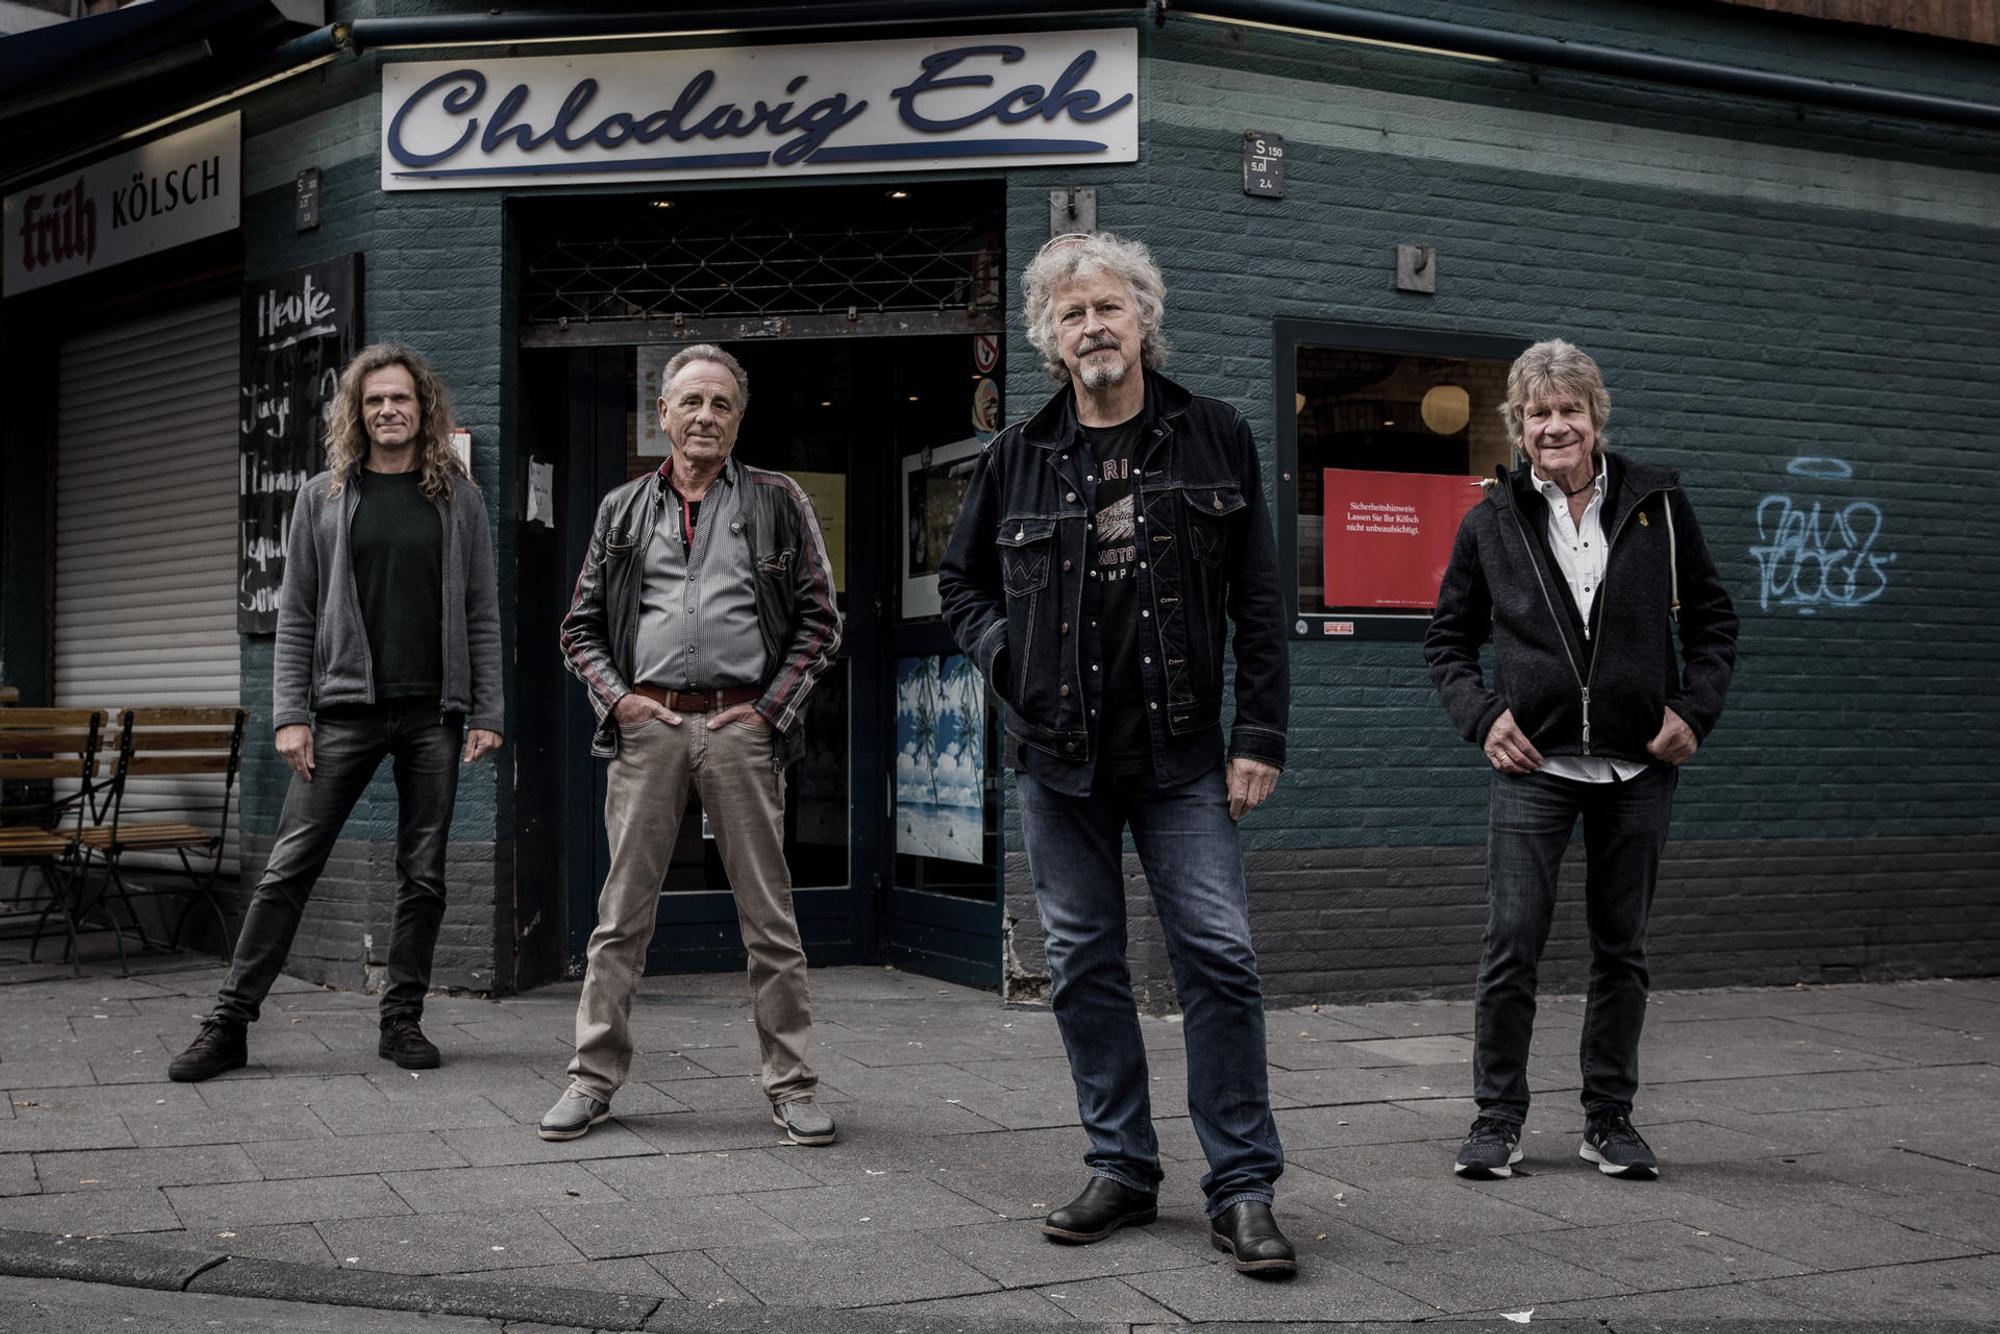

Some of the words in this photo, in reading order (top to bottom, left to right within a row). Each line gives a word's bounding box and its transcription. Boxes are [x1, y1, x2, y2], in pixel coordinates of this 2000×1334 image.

[387, 68, 869, 167] Chlodwig
[891, 45, 1134, 133] Eck
[1256, 140, 1266, 154] S
[112, 156, 220, 229] KÖLSCH
[1259, 178, 1272, 189] 2.4
[258, 274, 336, 337] Heute
[1097, 458, 1129, 484] RI
[1347, 511, 1371, 521] Lassen
[1372, 513, 1383, 522] Sie
[1384, 513, 1395, 523] Ihr
[1396, 514, 1419, 524] Kölsch
[1347, 522, 1365, 532] nicht
